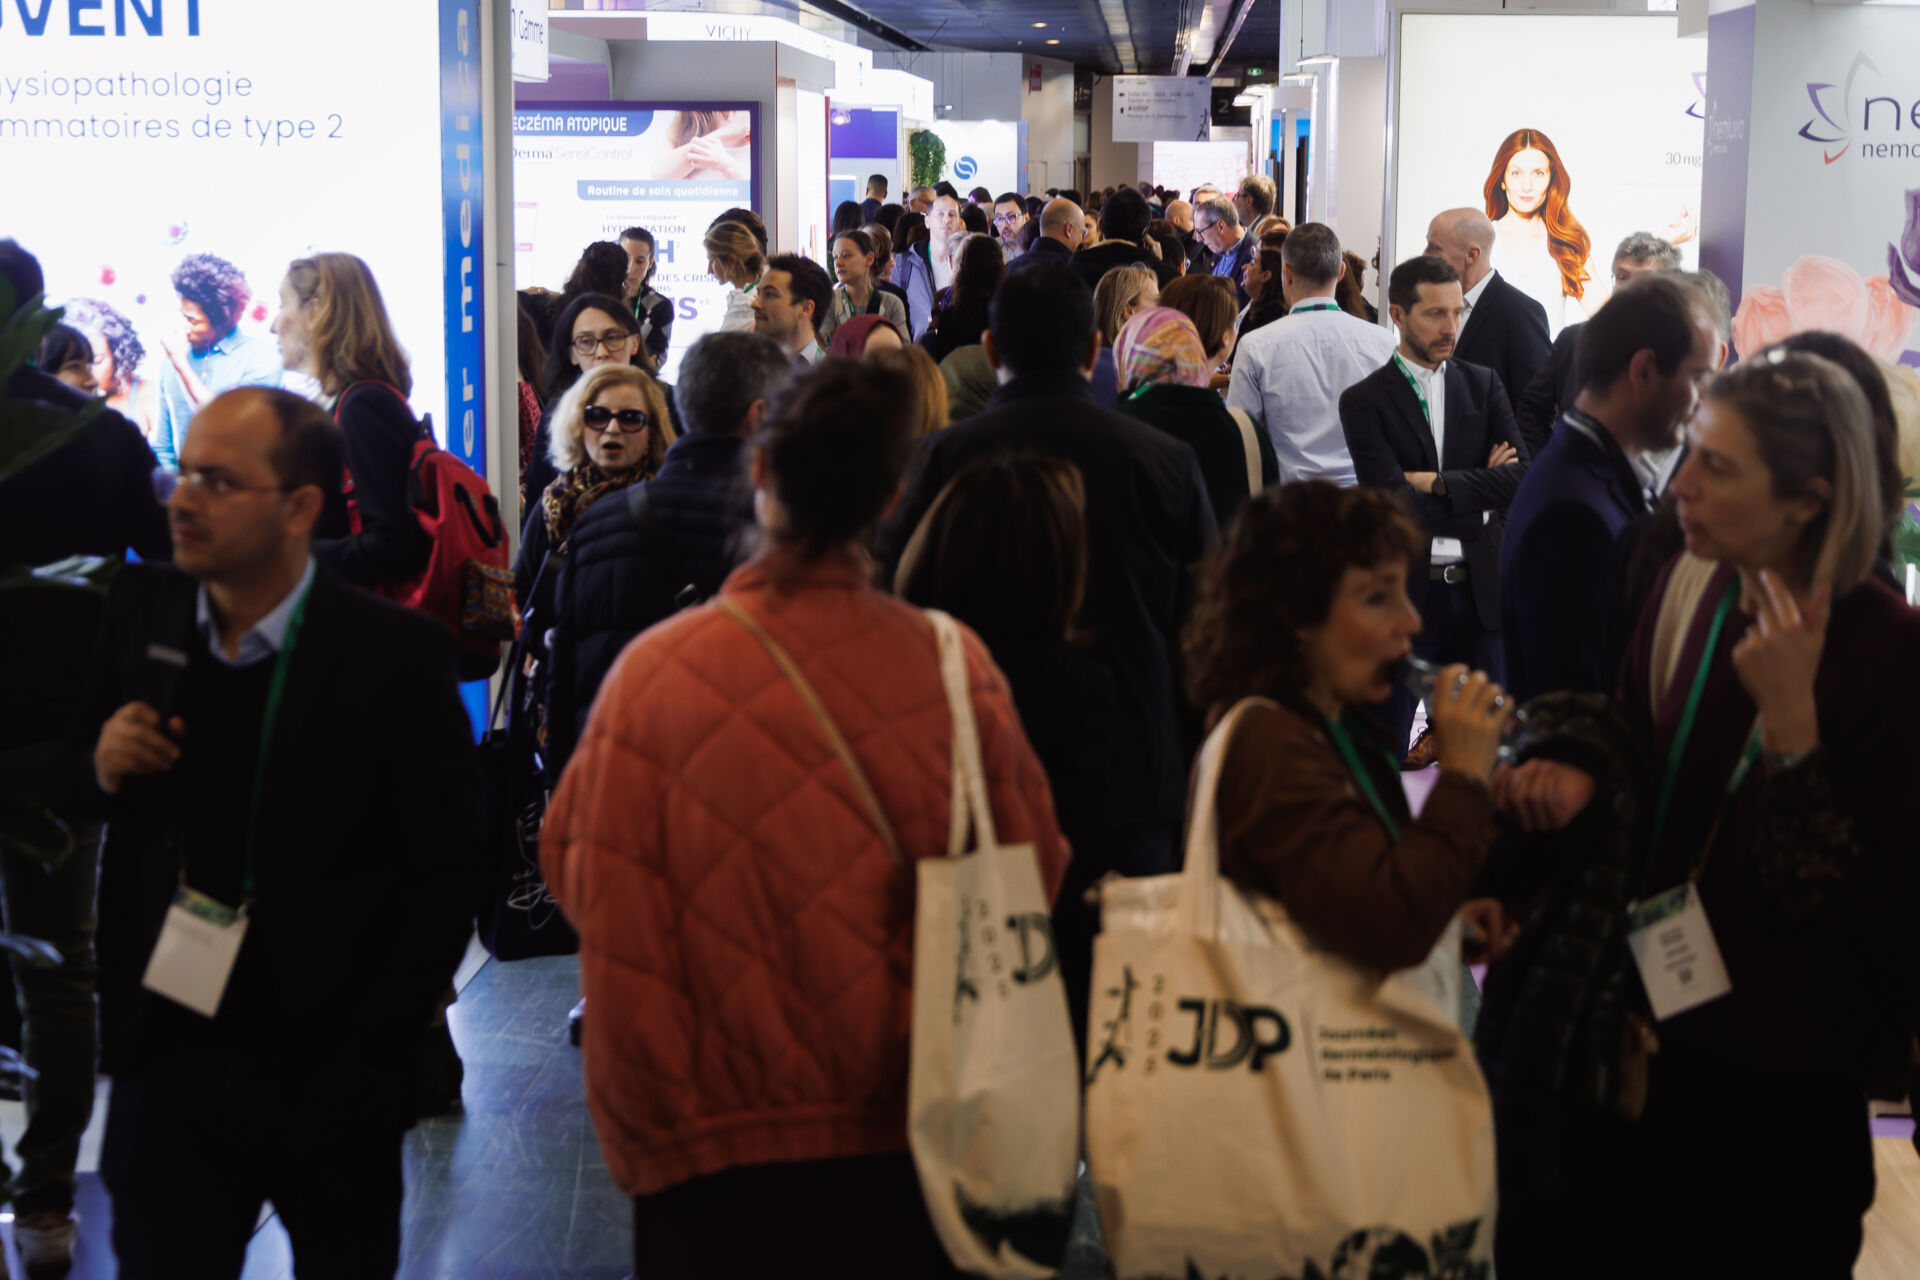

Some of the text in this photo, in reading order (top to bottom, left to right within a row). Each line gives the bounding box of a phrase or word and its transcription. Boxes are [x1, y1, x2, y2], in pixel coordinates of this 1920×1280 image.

[0, 0, 200, 36] VENT
[706, 24, 751, 41] VICHY
[0, 70, 253, 105] ysiopathologie
[191, 113, 232, 138] de
[243, 114, 316, 147] type
[327, 113, 344, 138] 2
[567, 116, 628, 134] ATOPIQUE
[1665, 152, 1702, 168] 30 mg
[587, 185, 739, 198] Routine de soin quotidienne
[602, 224, 686, 233] HYDTATION
[462, 367, 475, 474] er
[1166, 998, 1291, 1072] JDP
